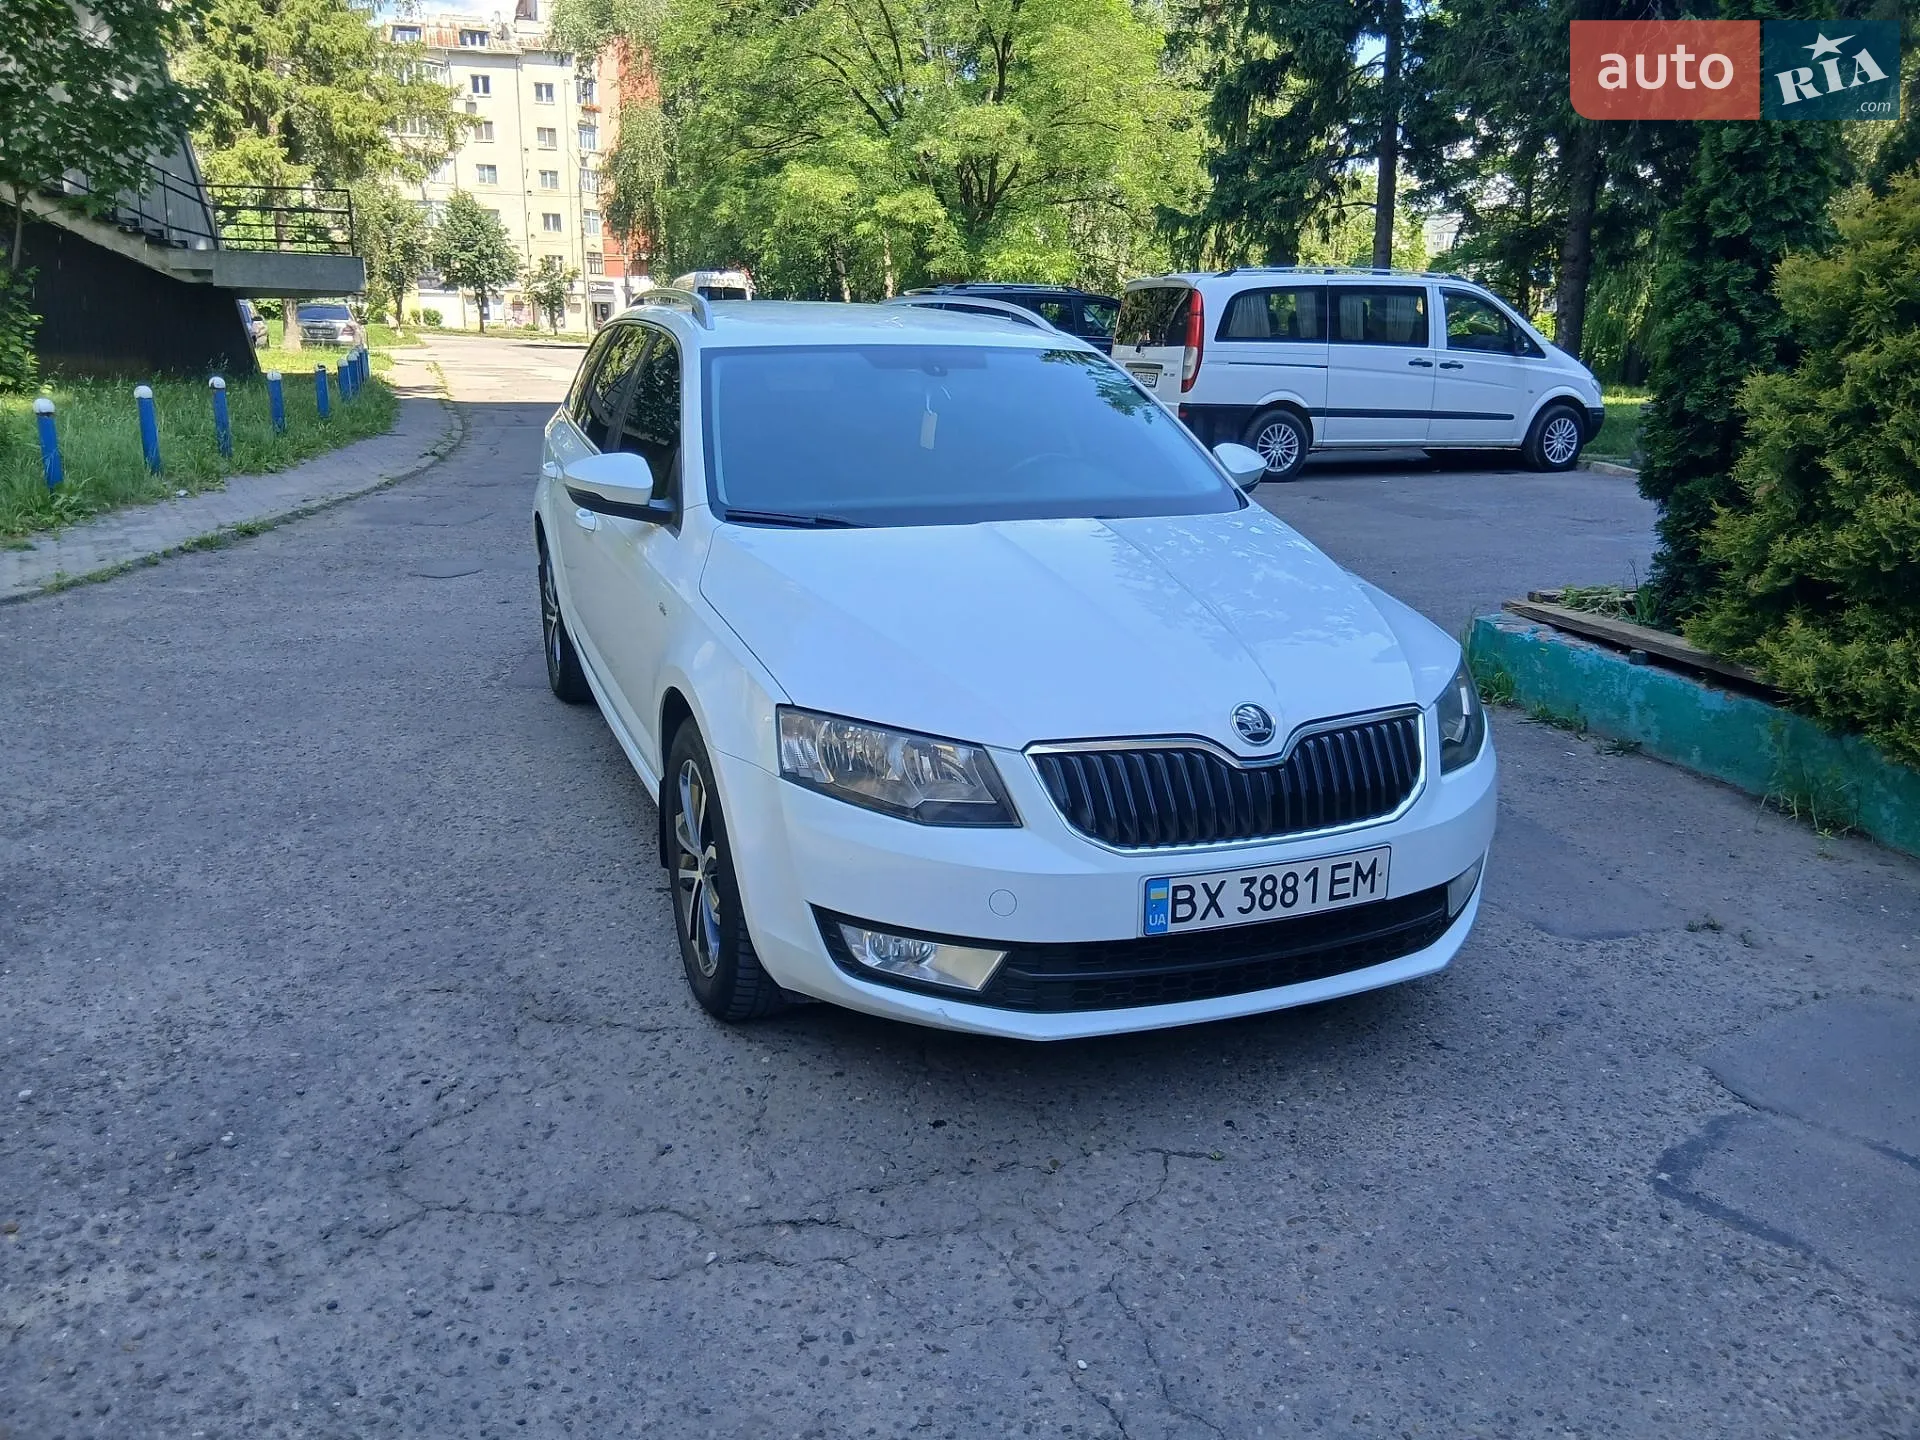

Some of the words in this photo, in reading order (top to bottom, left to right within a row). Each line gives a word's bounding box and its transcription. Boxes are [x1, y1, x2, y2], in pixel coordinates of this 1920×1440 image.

[1170, 880, 1226, 924] BX
[1237, 868, 1319, 915] 3881
[1328, 857, 1378, 901] EM
[1149, 914, 1166, 926] UA
